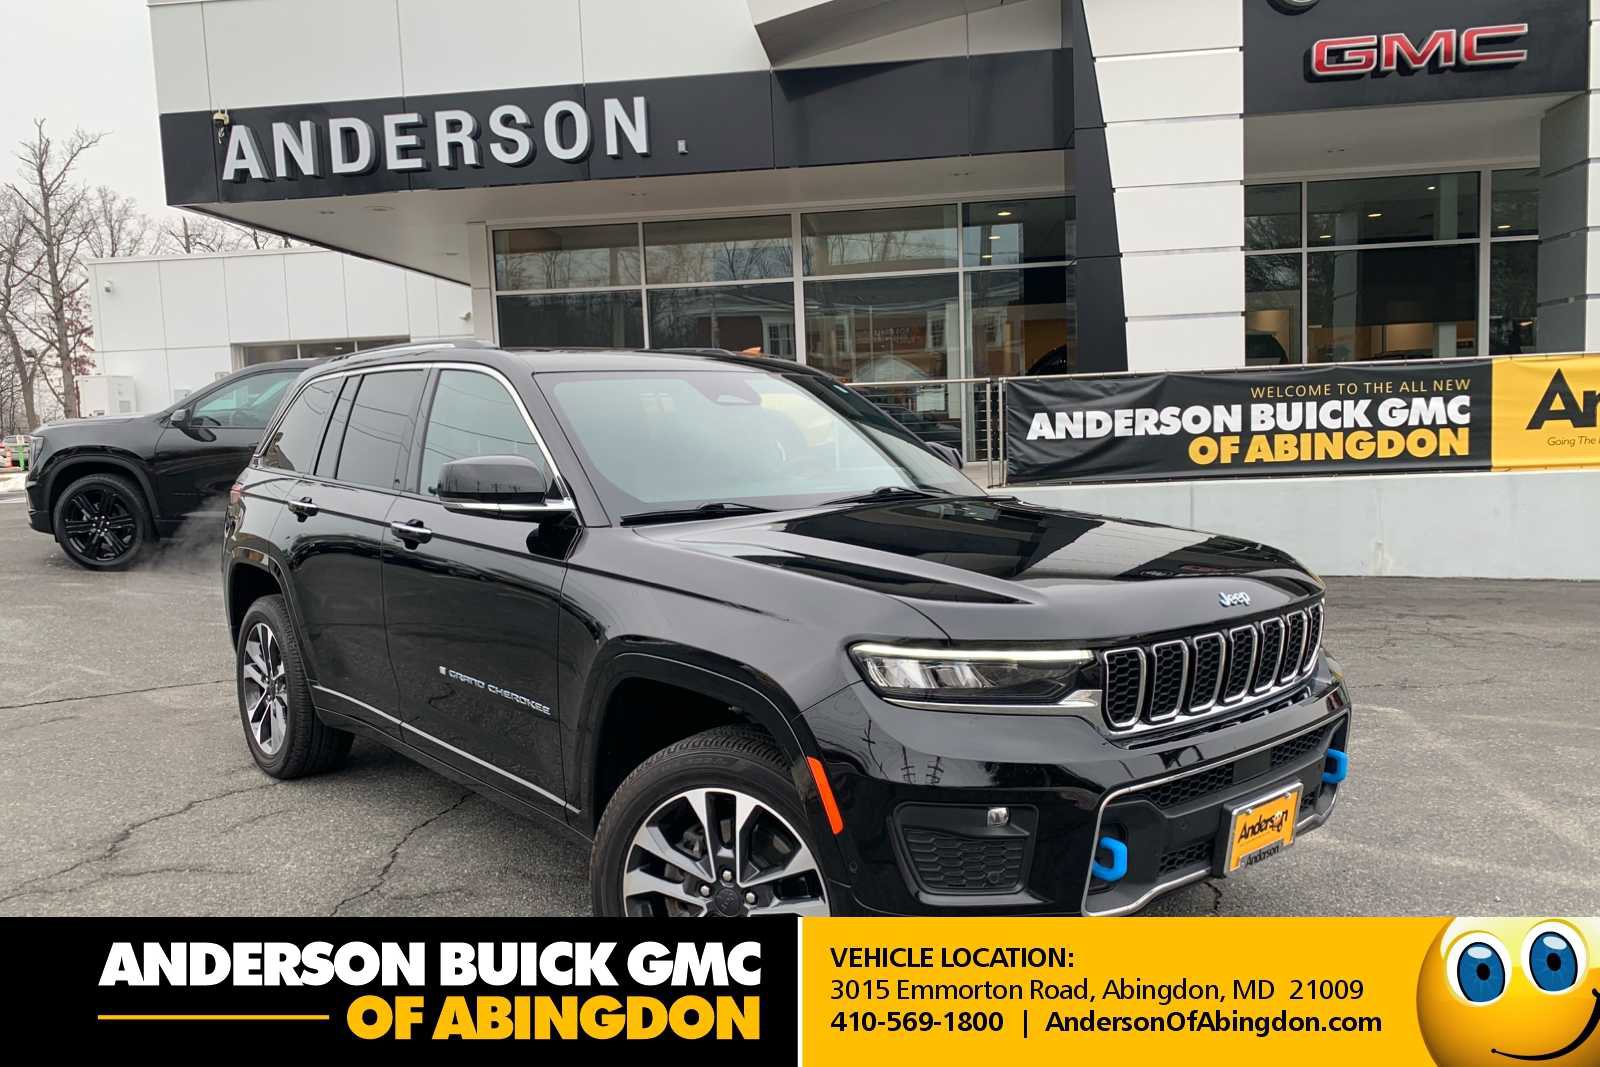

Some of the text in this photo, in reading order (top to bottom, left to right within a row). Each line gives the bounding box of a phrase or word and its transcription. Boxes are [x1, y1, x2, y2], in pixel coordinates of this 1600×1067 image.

[1311, 23, 1528, 76] GMC
[222, 96, 651, 182] ANDERSON
[1251, 379, 1471, 399] WELCOME TO THE ALL NEW
[1026, 395, 1471, 441] ANDERSON BUICK GMC
[1188, 427, 1470, 465] OF ABINGDON
[1547, 435, 1597, 447] Going The
[1218, 592, 1250, 607] Jeep
[448, 669, 552, 716] GRAND CHEROKEE
